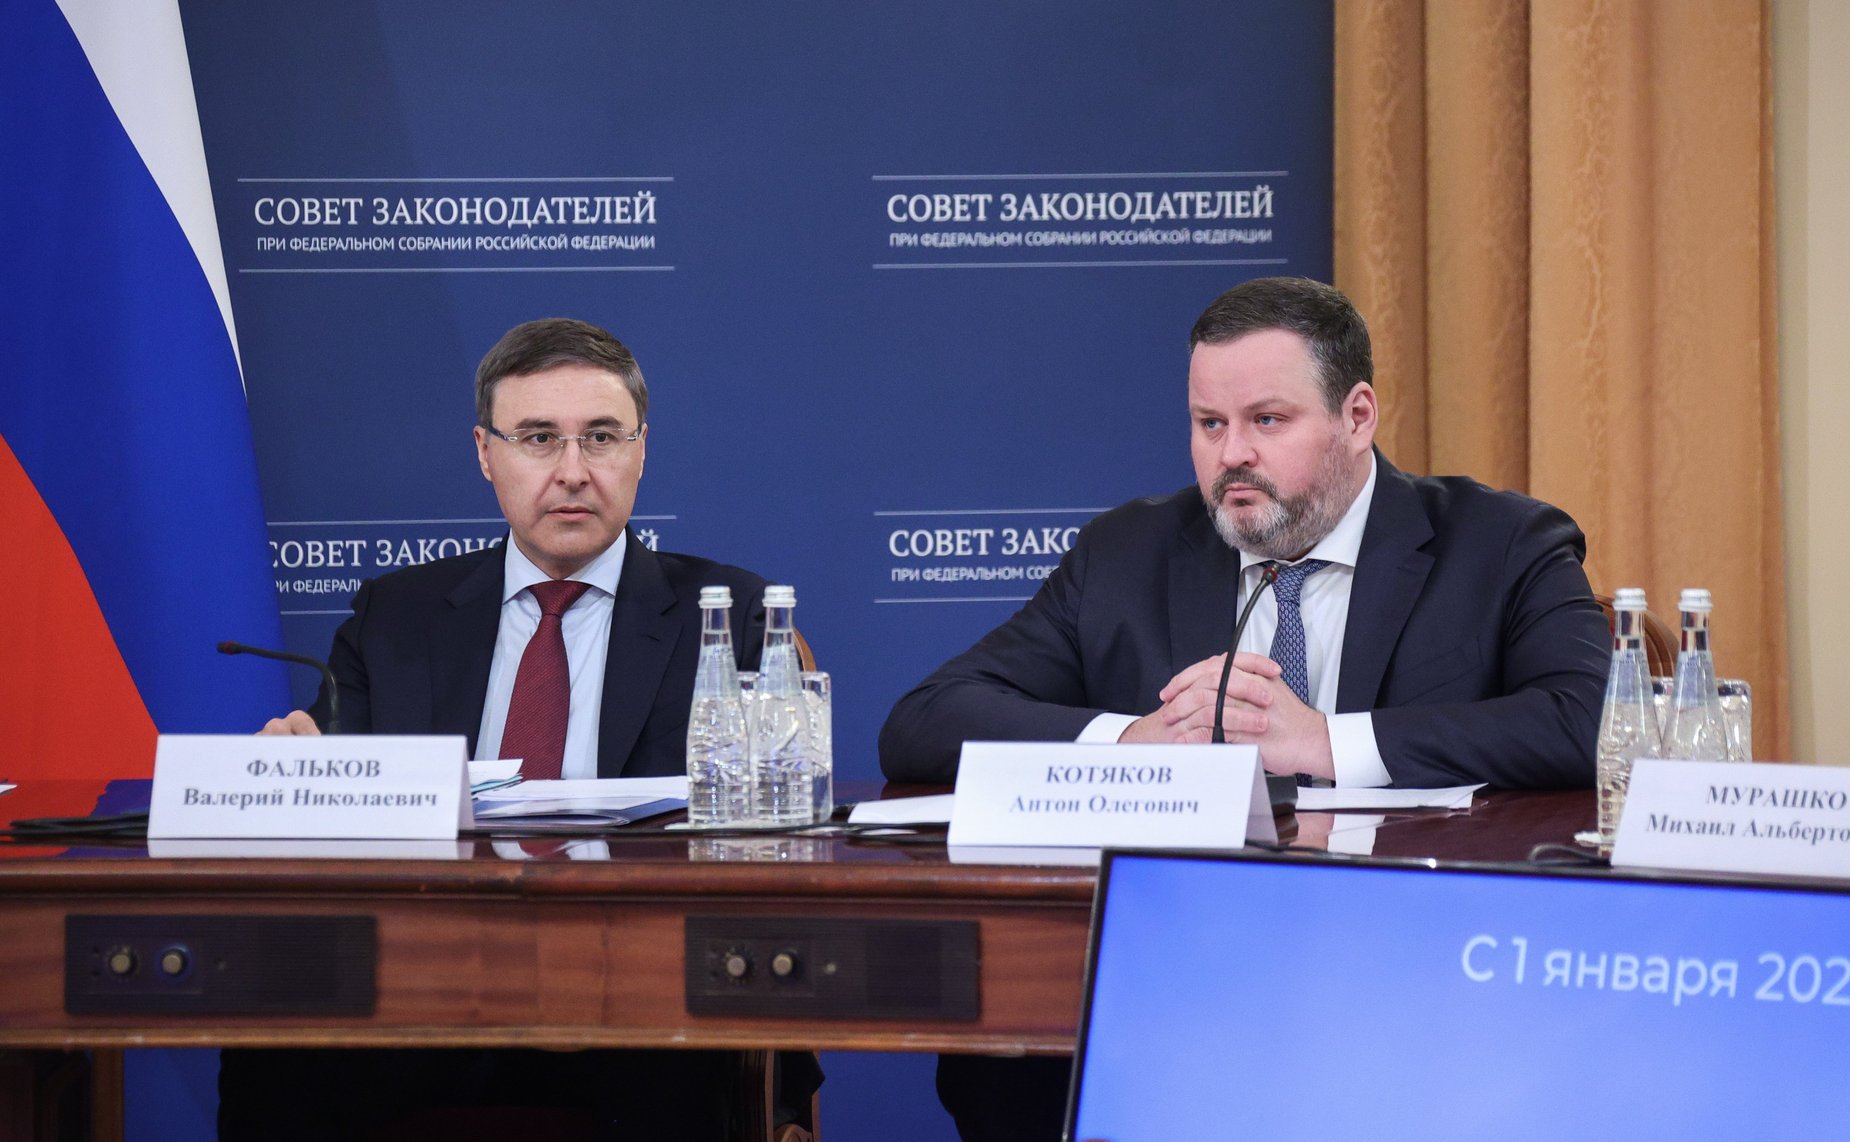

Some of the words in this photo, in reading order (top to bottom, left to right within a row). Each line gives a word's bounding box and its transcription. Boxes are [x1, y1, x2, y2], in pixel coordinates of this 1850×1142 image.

[254, 198, 363, 226] СОВЕТ
[372, 190, 657, 229] ЗАКОНОДАТЕЛЕЙ
[887, 194, 993, 223] СОВЕТ
[999, 185, 1273, 224] ЗАКОНОДАТЕЛЕЙ
[257, 237, 286, 251] ПРИ
[289, 237, 395, 253] ФЕДЕРАЛЬНОМ
[398, 237, 472, 251] СОБРАНИИ
[475, 233, 569, 252] РОССИЙСКОЙ
[570, 235, 656, 252] ФЕДЕРАЦИИ
[889, 233, 919, 247] ПРИ
[920, 232, 1023, 248] ФЕДЕРАЛЬНОМ
[1024, 231, 1098, 247] СОБРАНИИ
[1099, 228, 1191, 247] РОССИЙСКОЙ
[1192, 229, 1273, 246] ФЕДЕРАЦИИ
[888, 529, 995, 557] СОВЕТ
[891, 568, 920, 582] ПРИ
[922, 566, 1024, 583] ФЕДЕРАЛЬНОМ
[246, 760, 381, 779] ФАЛЬКОВ
[1046, 766, 1172, 784] КОТЯКОВ
[183, 788, 284, 811] Валерий
[292, 789, 438, 808] Николаевич
[1010, 796, 1081, 814] Антон
[1088, 796, 1199, 814] Олегович
[1707, 785, 1848, 811] МУРАШКО
[1647, 814, 1736, 837] Михаил
[1744, 819, 1850, 847] Альберто
[1461, 934, 1499, 983] С
[1512, 936, 1528, 985] 1
[1542, 949, 1739, 1008] января
[1754, 953, 1850, 1007] 202
